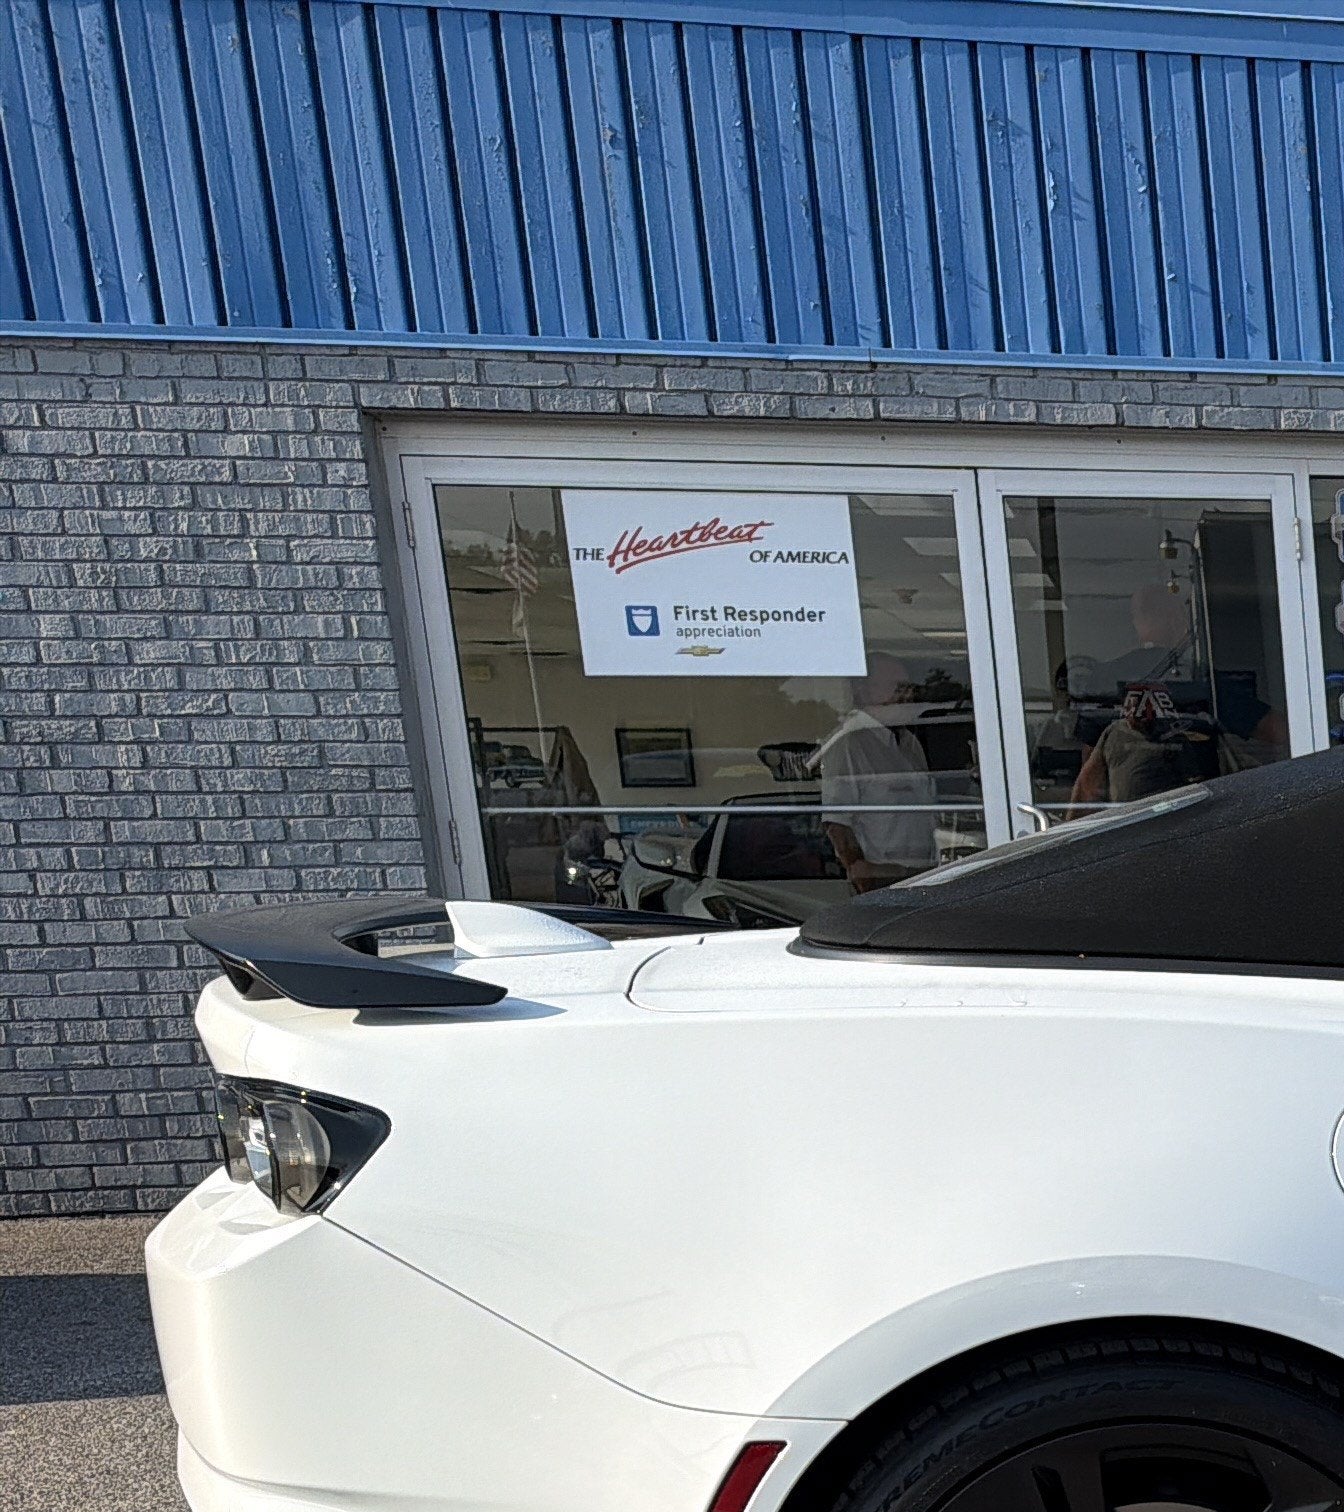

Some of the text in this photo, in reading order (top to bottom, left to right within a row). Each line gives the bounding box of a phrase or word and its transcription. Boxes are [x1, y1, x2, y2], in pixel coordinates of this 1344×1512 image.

[573, 517, 849, 574] THE Heartbeat OF AMERICA
[673, 605, 826, 625] First Responder
[676, 625, 761, 639] appreciation
